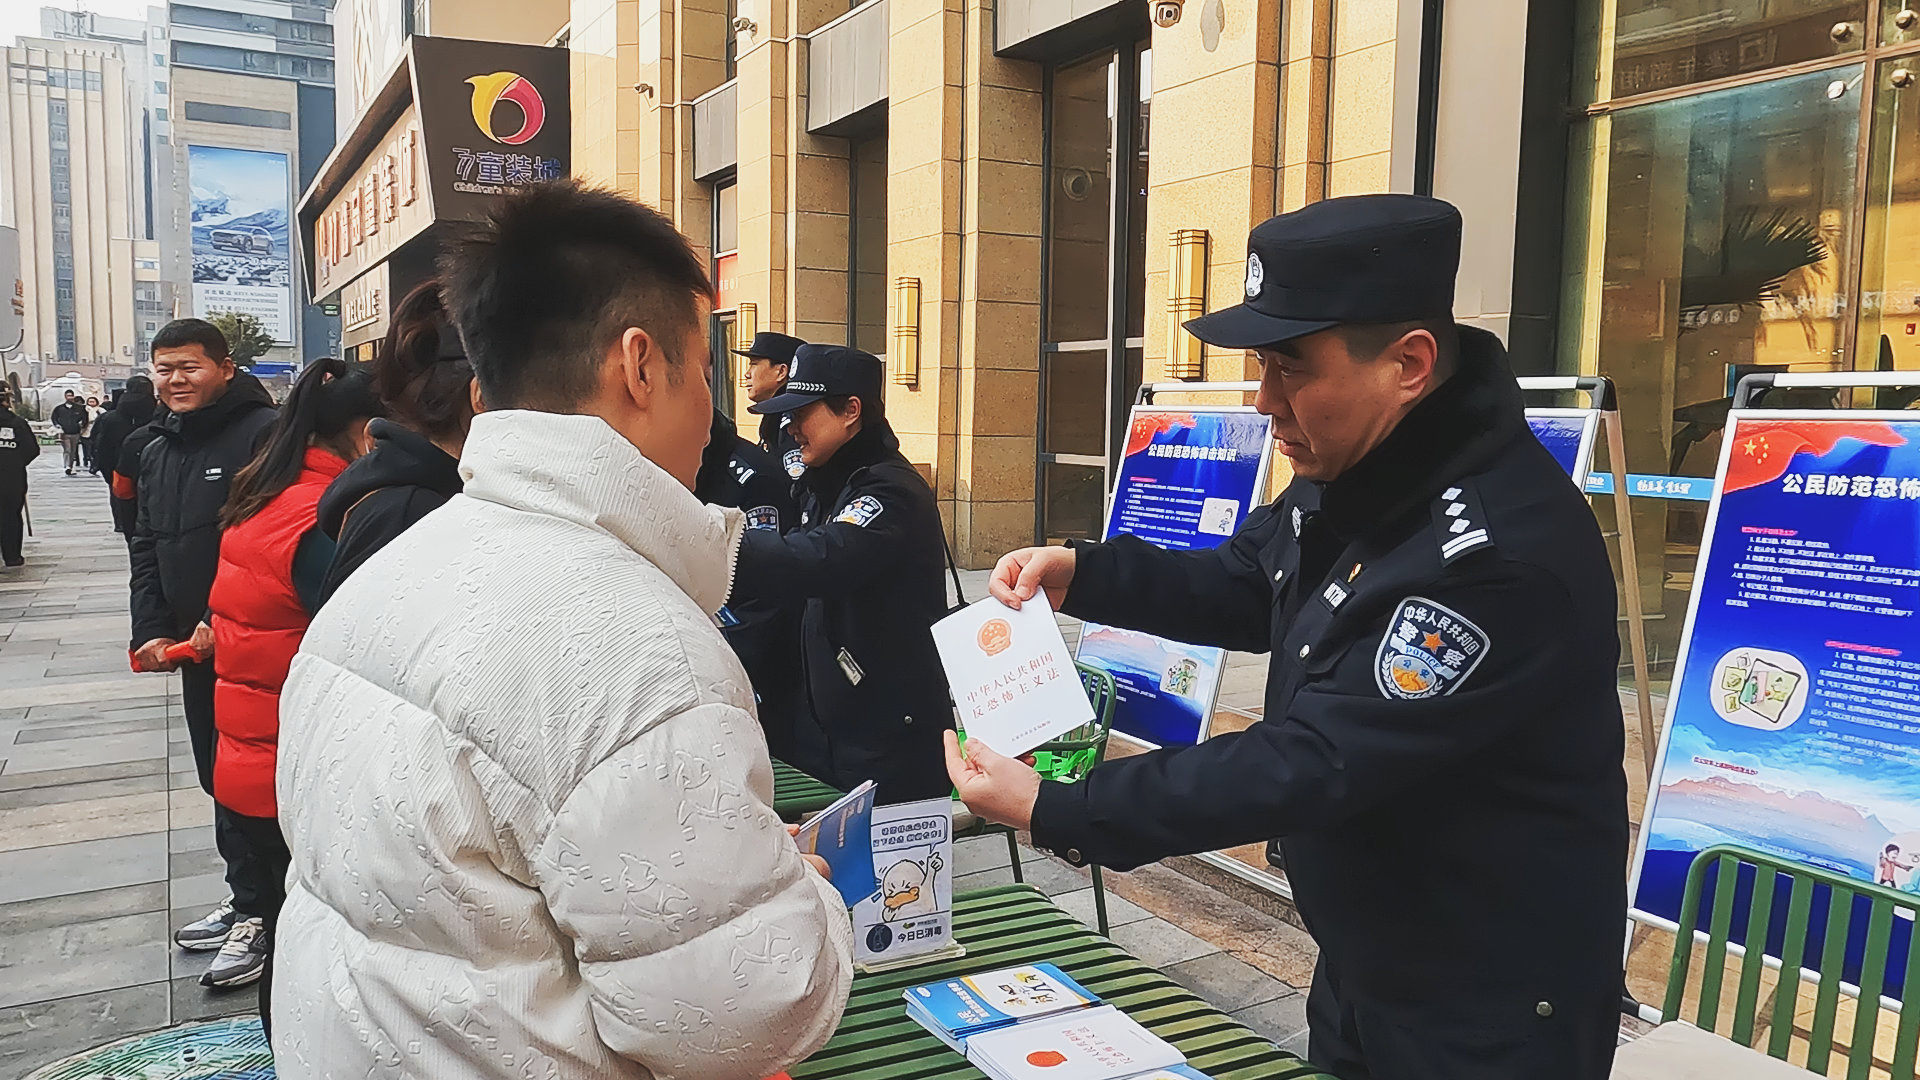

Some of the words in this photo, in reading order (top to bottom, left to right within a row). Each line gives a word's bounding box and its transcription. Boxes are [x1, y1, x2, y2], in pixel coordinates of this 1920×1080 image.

[1782, 473, 1920, 500] 公民防范恐怖
[1403, 605, 1480, 656] 中华人民共和国
[966, 651, 1054, 703] 中华人民共和国
[1405, 645, 1442, 670] POLICE
[972, 667, 1060, 719] 反恐怖主义法
[898, 925, 942, 942] 今日已消毒
